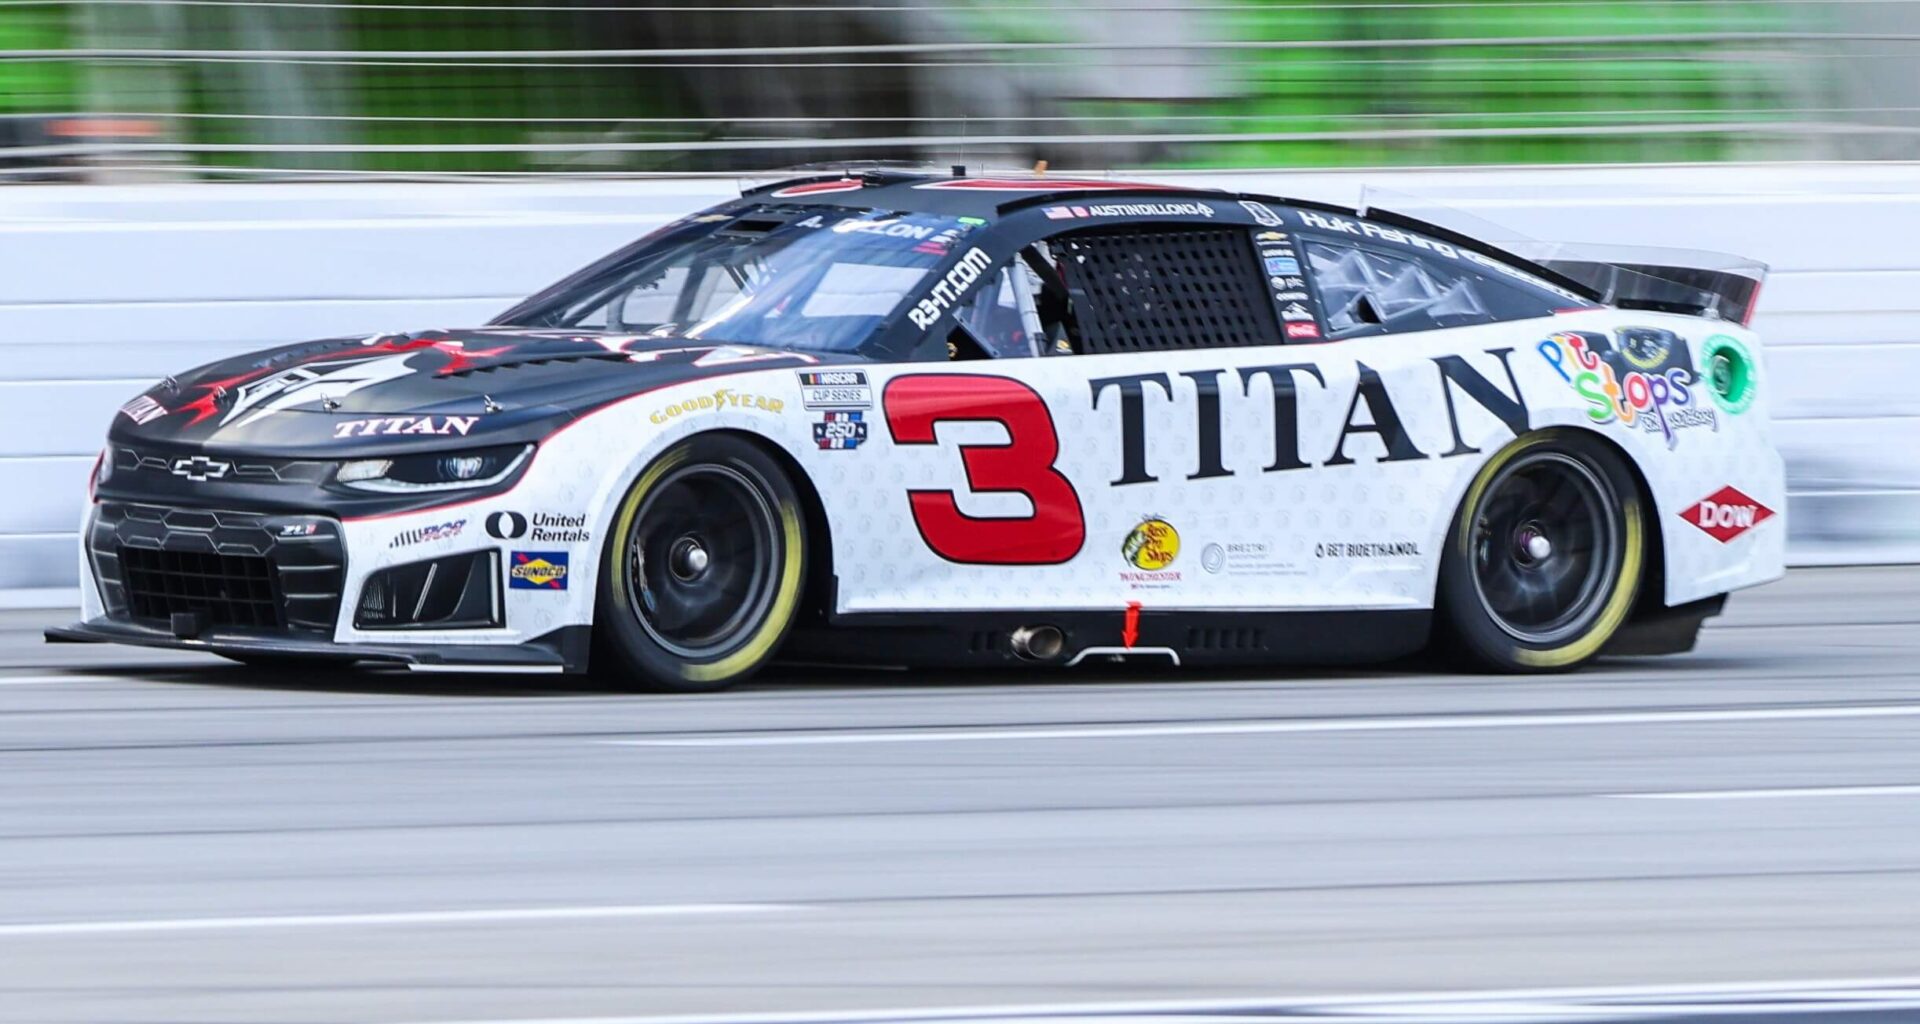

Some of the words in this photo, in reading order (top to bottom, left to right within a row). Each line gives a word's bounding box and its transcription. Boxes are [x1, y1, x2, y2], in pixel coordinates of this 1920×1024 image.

[832, 218, 933, 239] DLON
[1297, 211, 1360, 235] Huk
[1357, 221, 1460, 260] Fishing
[1537, 331, 1598, 384] Pit
[820, 373, 858, 385] NASCAR
[812, 389, 831, 401] CUP
[832, 389, 862, 401] SERIES
[1575, 362, 1691, 443] Stops
[649, 389, 785, 425] GOODYEAR
[1088, 345, 1534, 487] TITAN
[333, 415, 479, 438] TITAN
[825, 423, 856, 438] 250
[881, 373, 1086, 565] 3
[532, 512, 587, 528] United
[1699, 500, 1758, 528] DOW
[530, 528, 590, 542] Rentals
[1326, 542, 1345, 557] GET
[513, 565, 566, 577] SUNOCO
